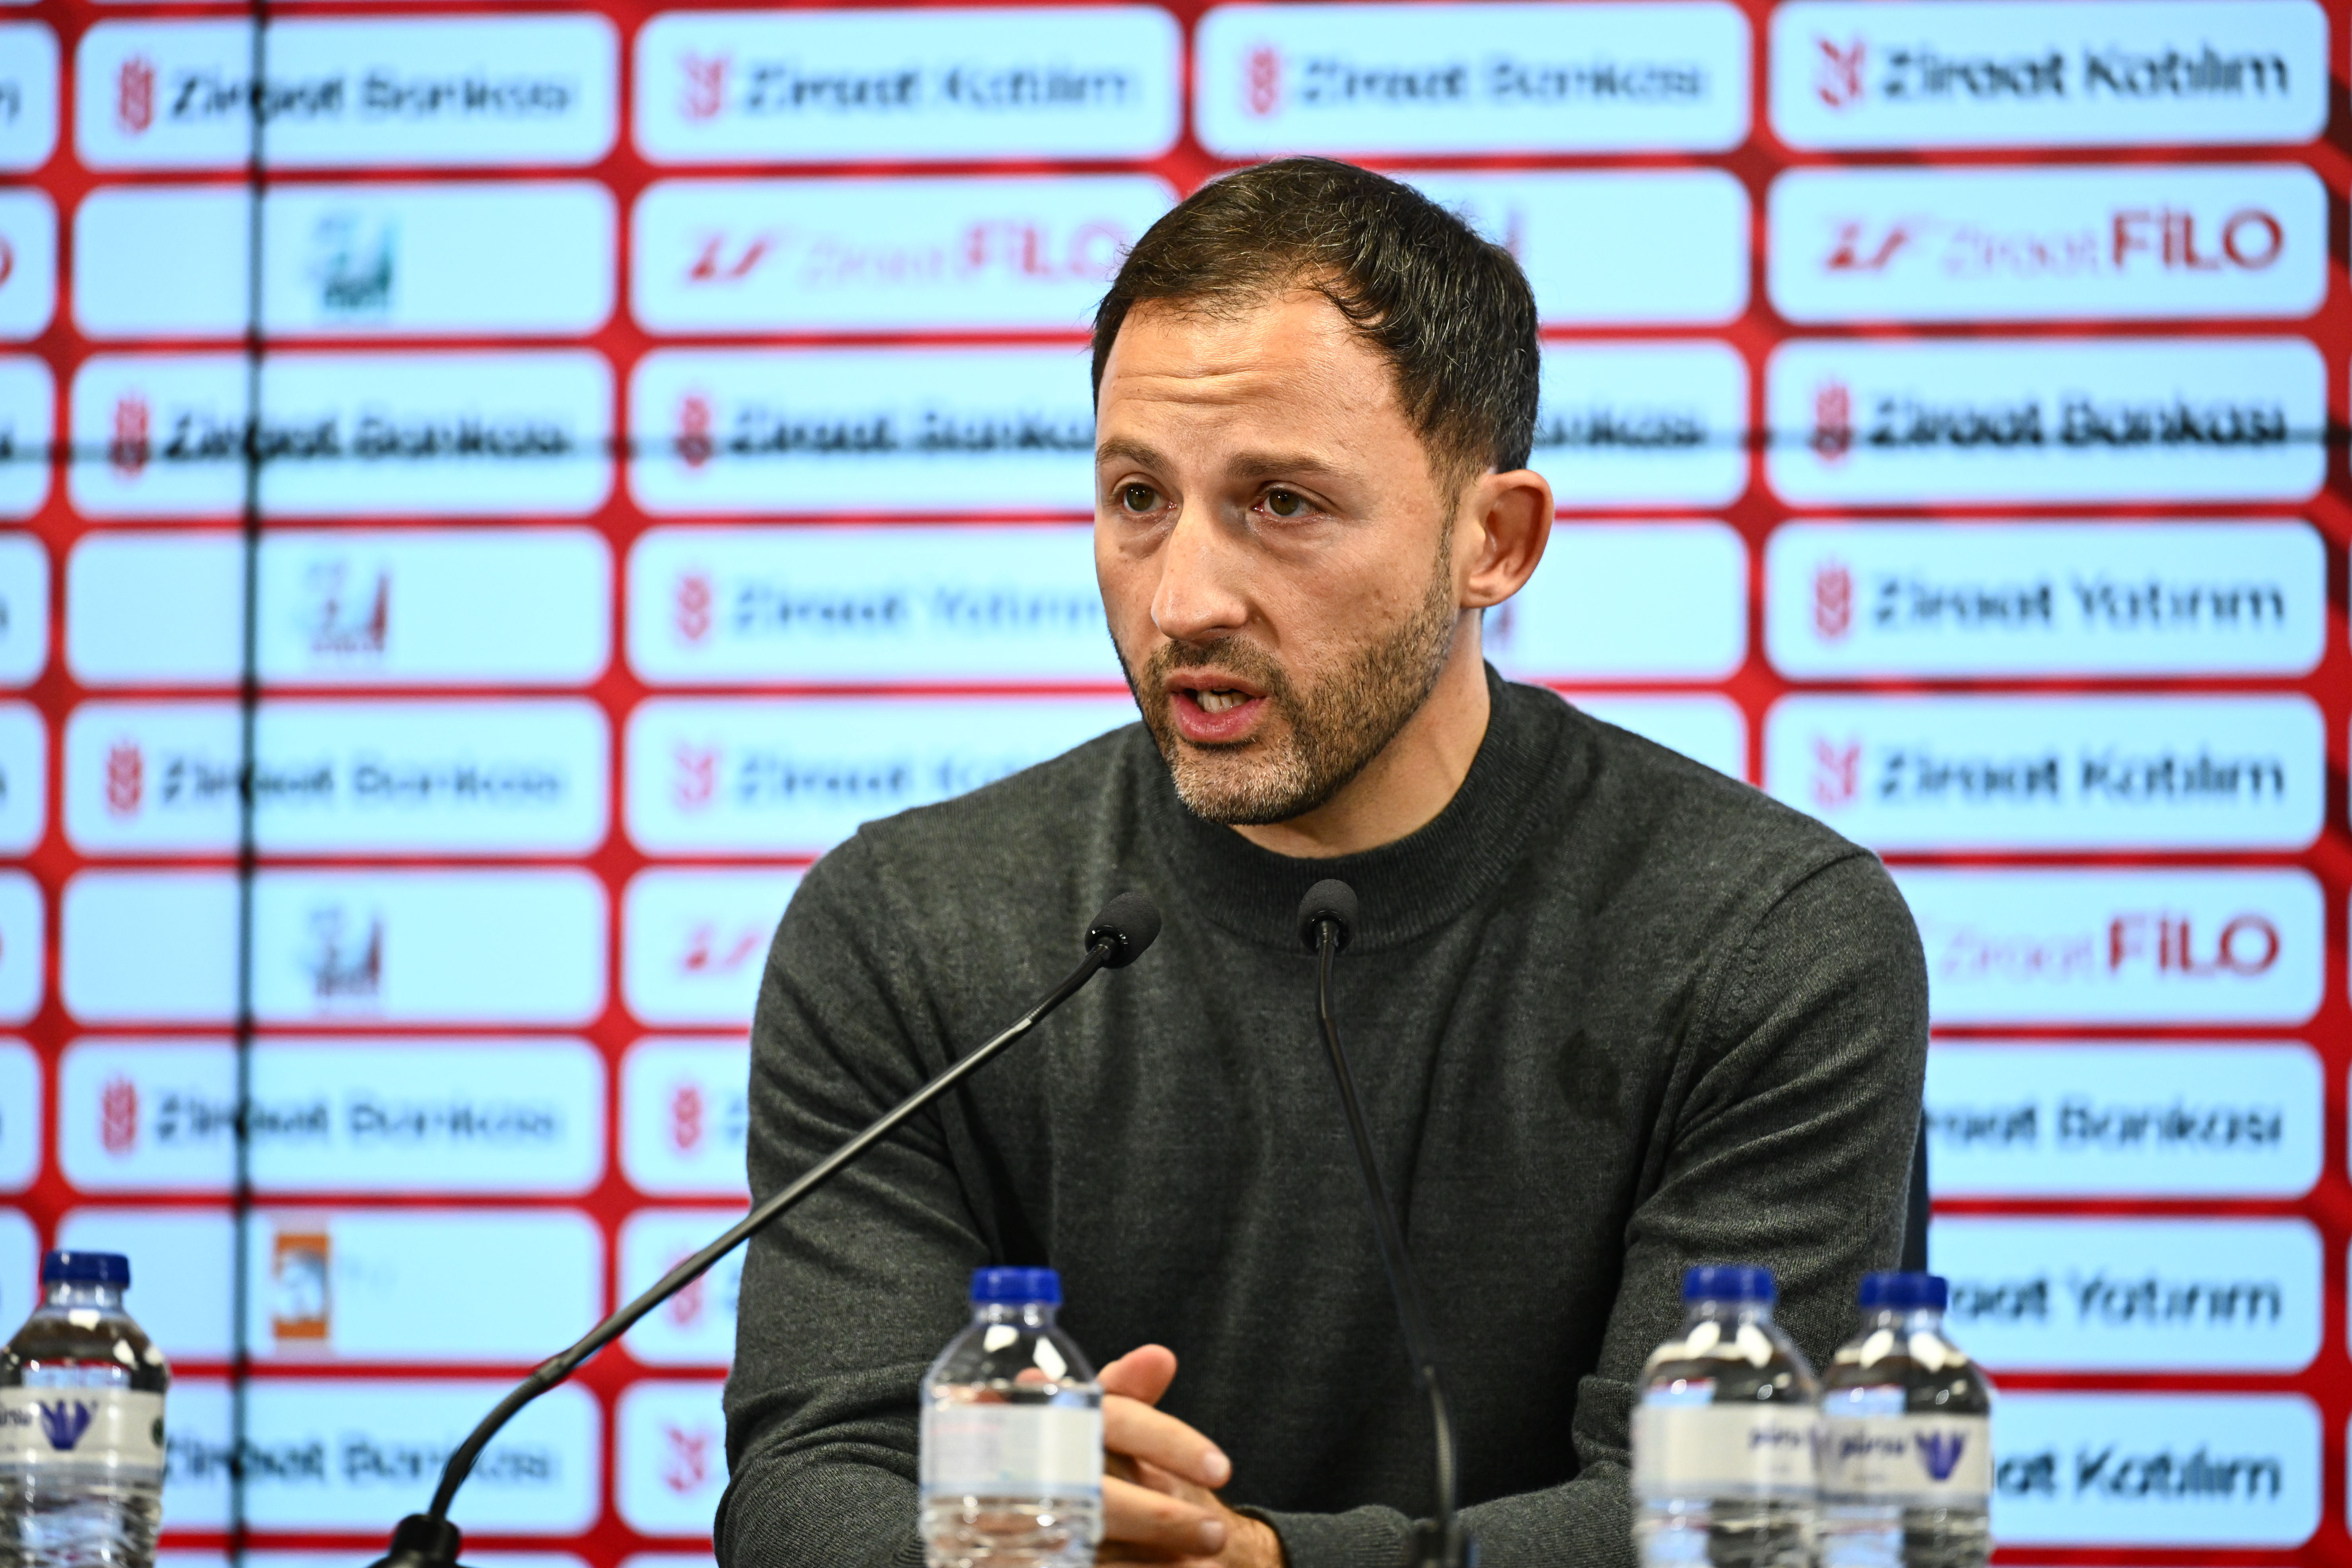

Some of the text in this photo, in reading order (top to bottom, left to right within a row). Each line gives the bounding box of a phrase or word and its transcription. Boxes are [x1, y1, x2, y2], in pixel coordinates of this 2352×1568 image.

[1882, 44, 2290, 97] Ziraat Katılım
[1869, 398, 2288, 449] Ziraat Bankası
[1873, 577, 2286, 627] Ziraat Yatırım
[1879, 748, 2286, 799] Ziraat Katılım
[2057, 1098, 2283, 1146] Bankası
[2070, 1273, 2283, 1323] Yatırım
[2075, 1445, 2282, 1497] Katılım
